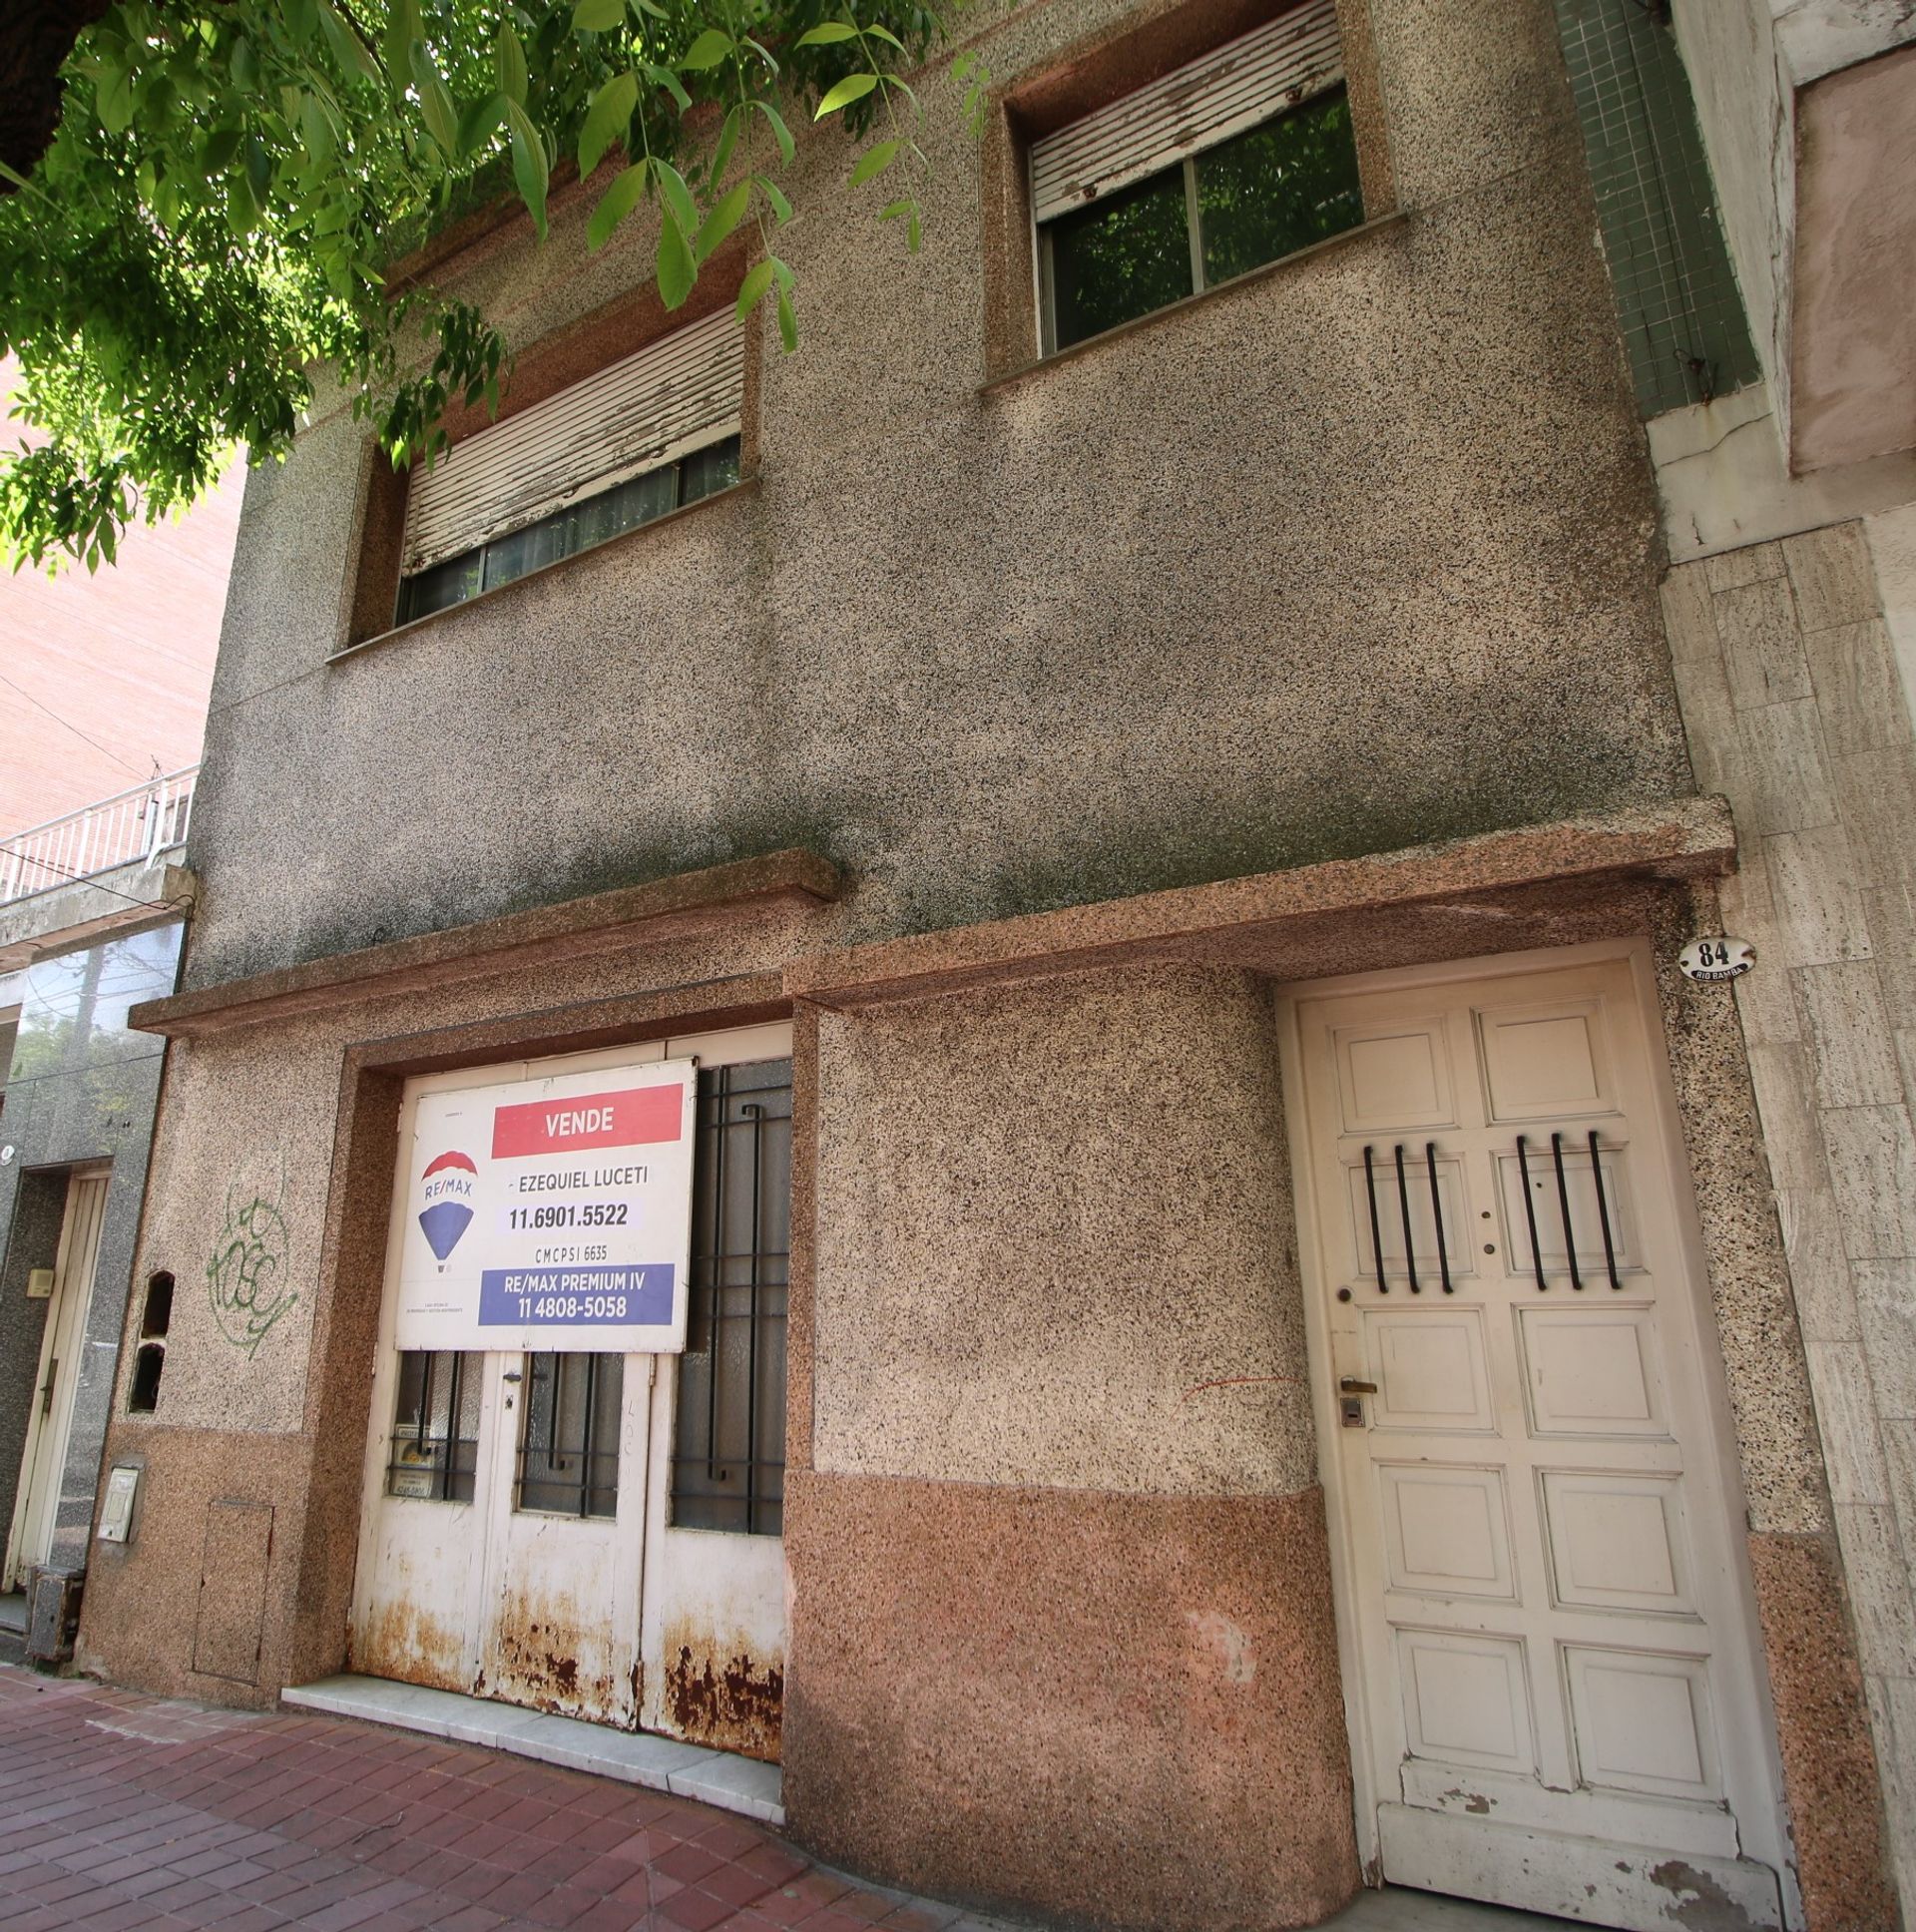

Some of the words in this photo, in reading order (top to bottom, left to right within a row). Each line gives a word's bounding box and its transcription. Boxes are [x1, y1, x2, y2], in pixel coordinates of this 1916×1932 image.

[1698, 941, 1729, 967] 84
[546, 1107, 615, 1138] VENDE
[425, 1179, 472, 1201] RE/MAX
[519, 1171, 590, 1193] EZEQUIEL
[594, 1166, 648, 1188] LUCETI
[509, 1204, 628, 1229] 11.6901.5522
[584, 1244, 608, 1261] 6635
[504, 1273, 557, 1294] RE/MAX
[561, 1272, 627, 1291] PREMIUM
[630, 1271, 646, 1289] IV
[518, 1298, 531, 1318] 11
[535, 1296, 627, 1318] 4808-5058
